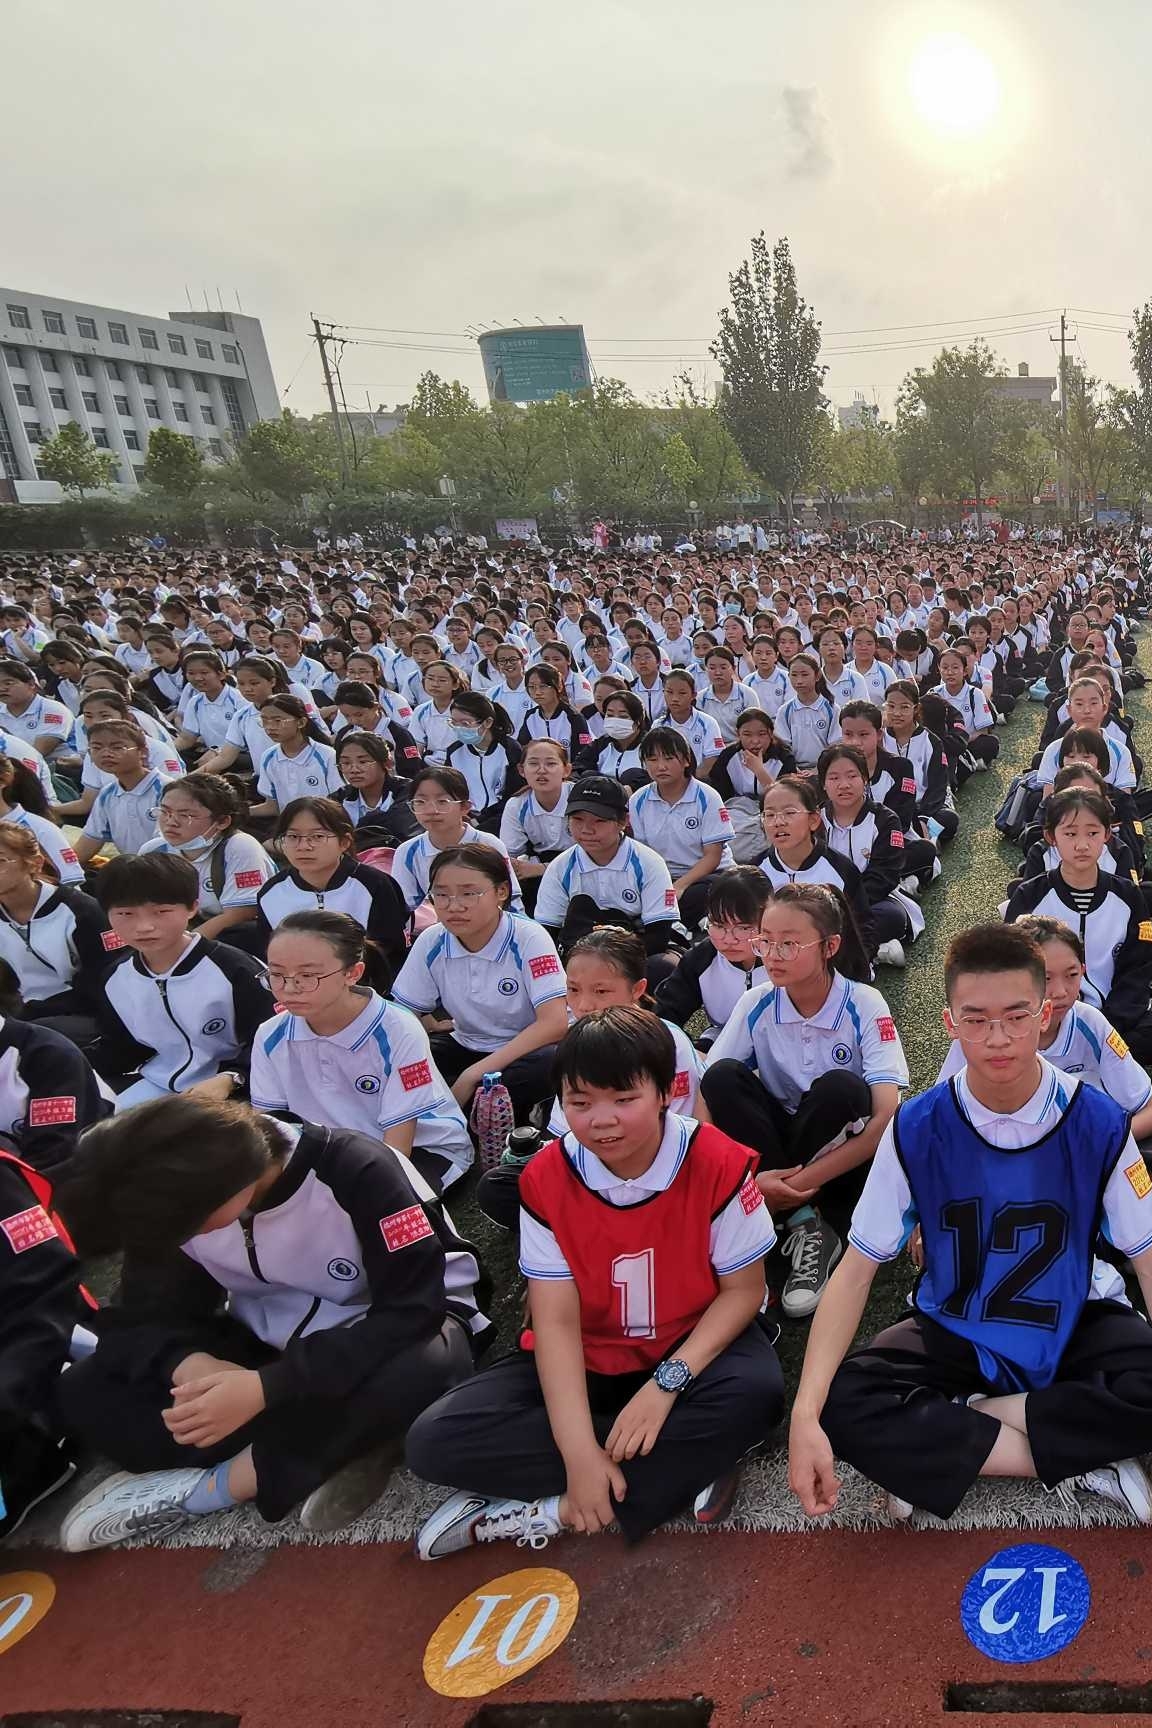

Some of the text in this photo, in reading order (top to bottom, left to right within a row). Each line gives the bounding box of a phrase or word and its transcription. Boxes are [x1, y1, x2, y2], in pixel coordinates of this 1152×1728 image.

[611, 1247, 656, 1340] 1
[941, 1197, 1070, 1332] 12
[979, 1567, 1067, 1635] 12
